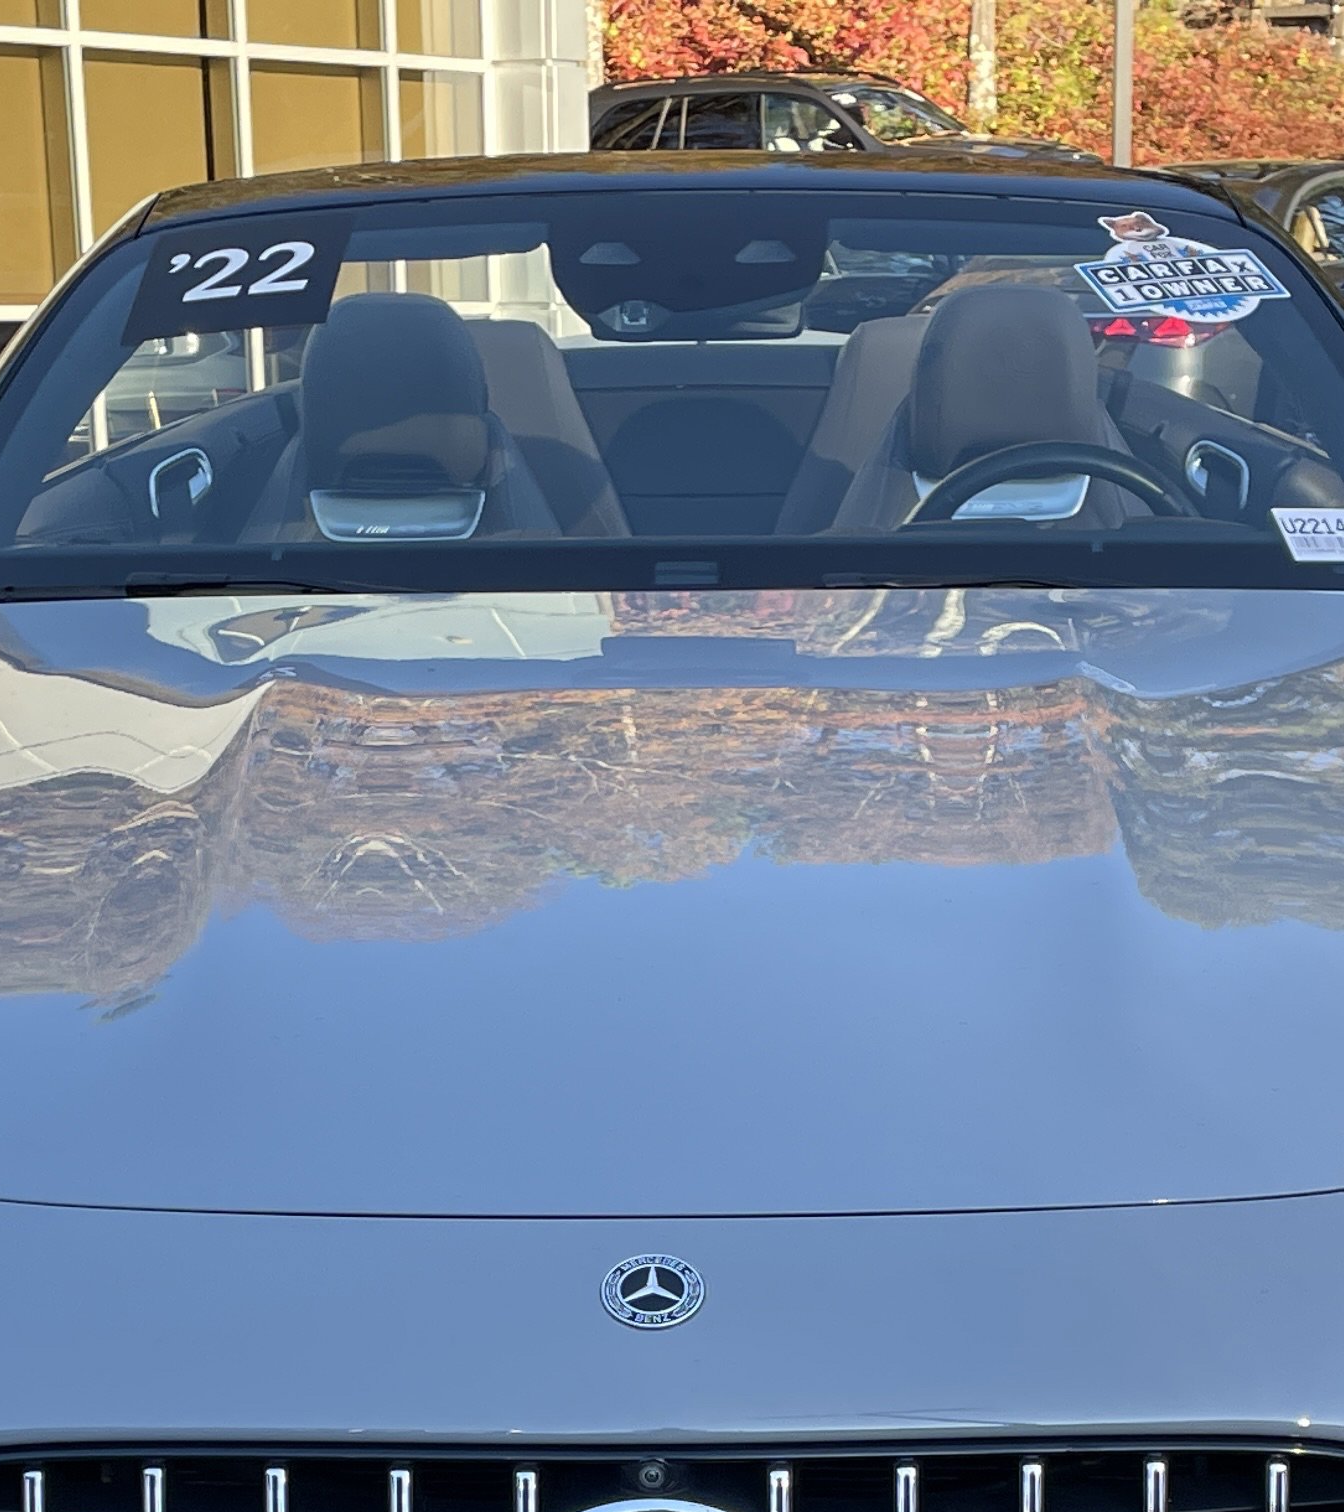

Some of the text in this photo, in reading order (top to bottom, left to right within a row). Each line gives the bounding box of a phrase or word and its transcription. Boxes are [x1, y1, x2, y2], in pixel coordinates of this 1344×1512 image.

[168, 241, 315, 302] '22
[1097, 257, 1254, 283] CARFAX
[1114, 275, 1269, 301] 1 OWNER
